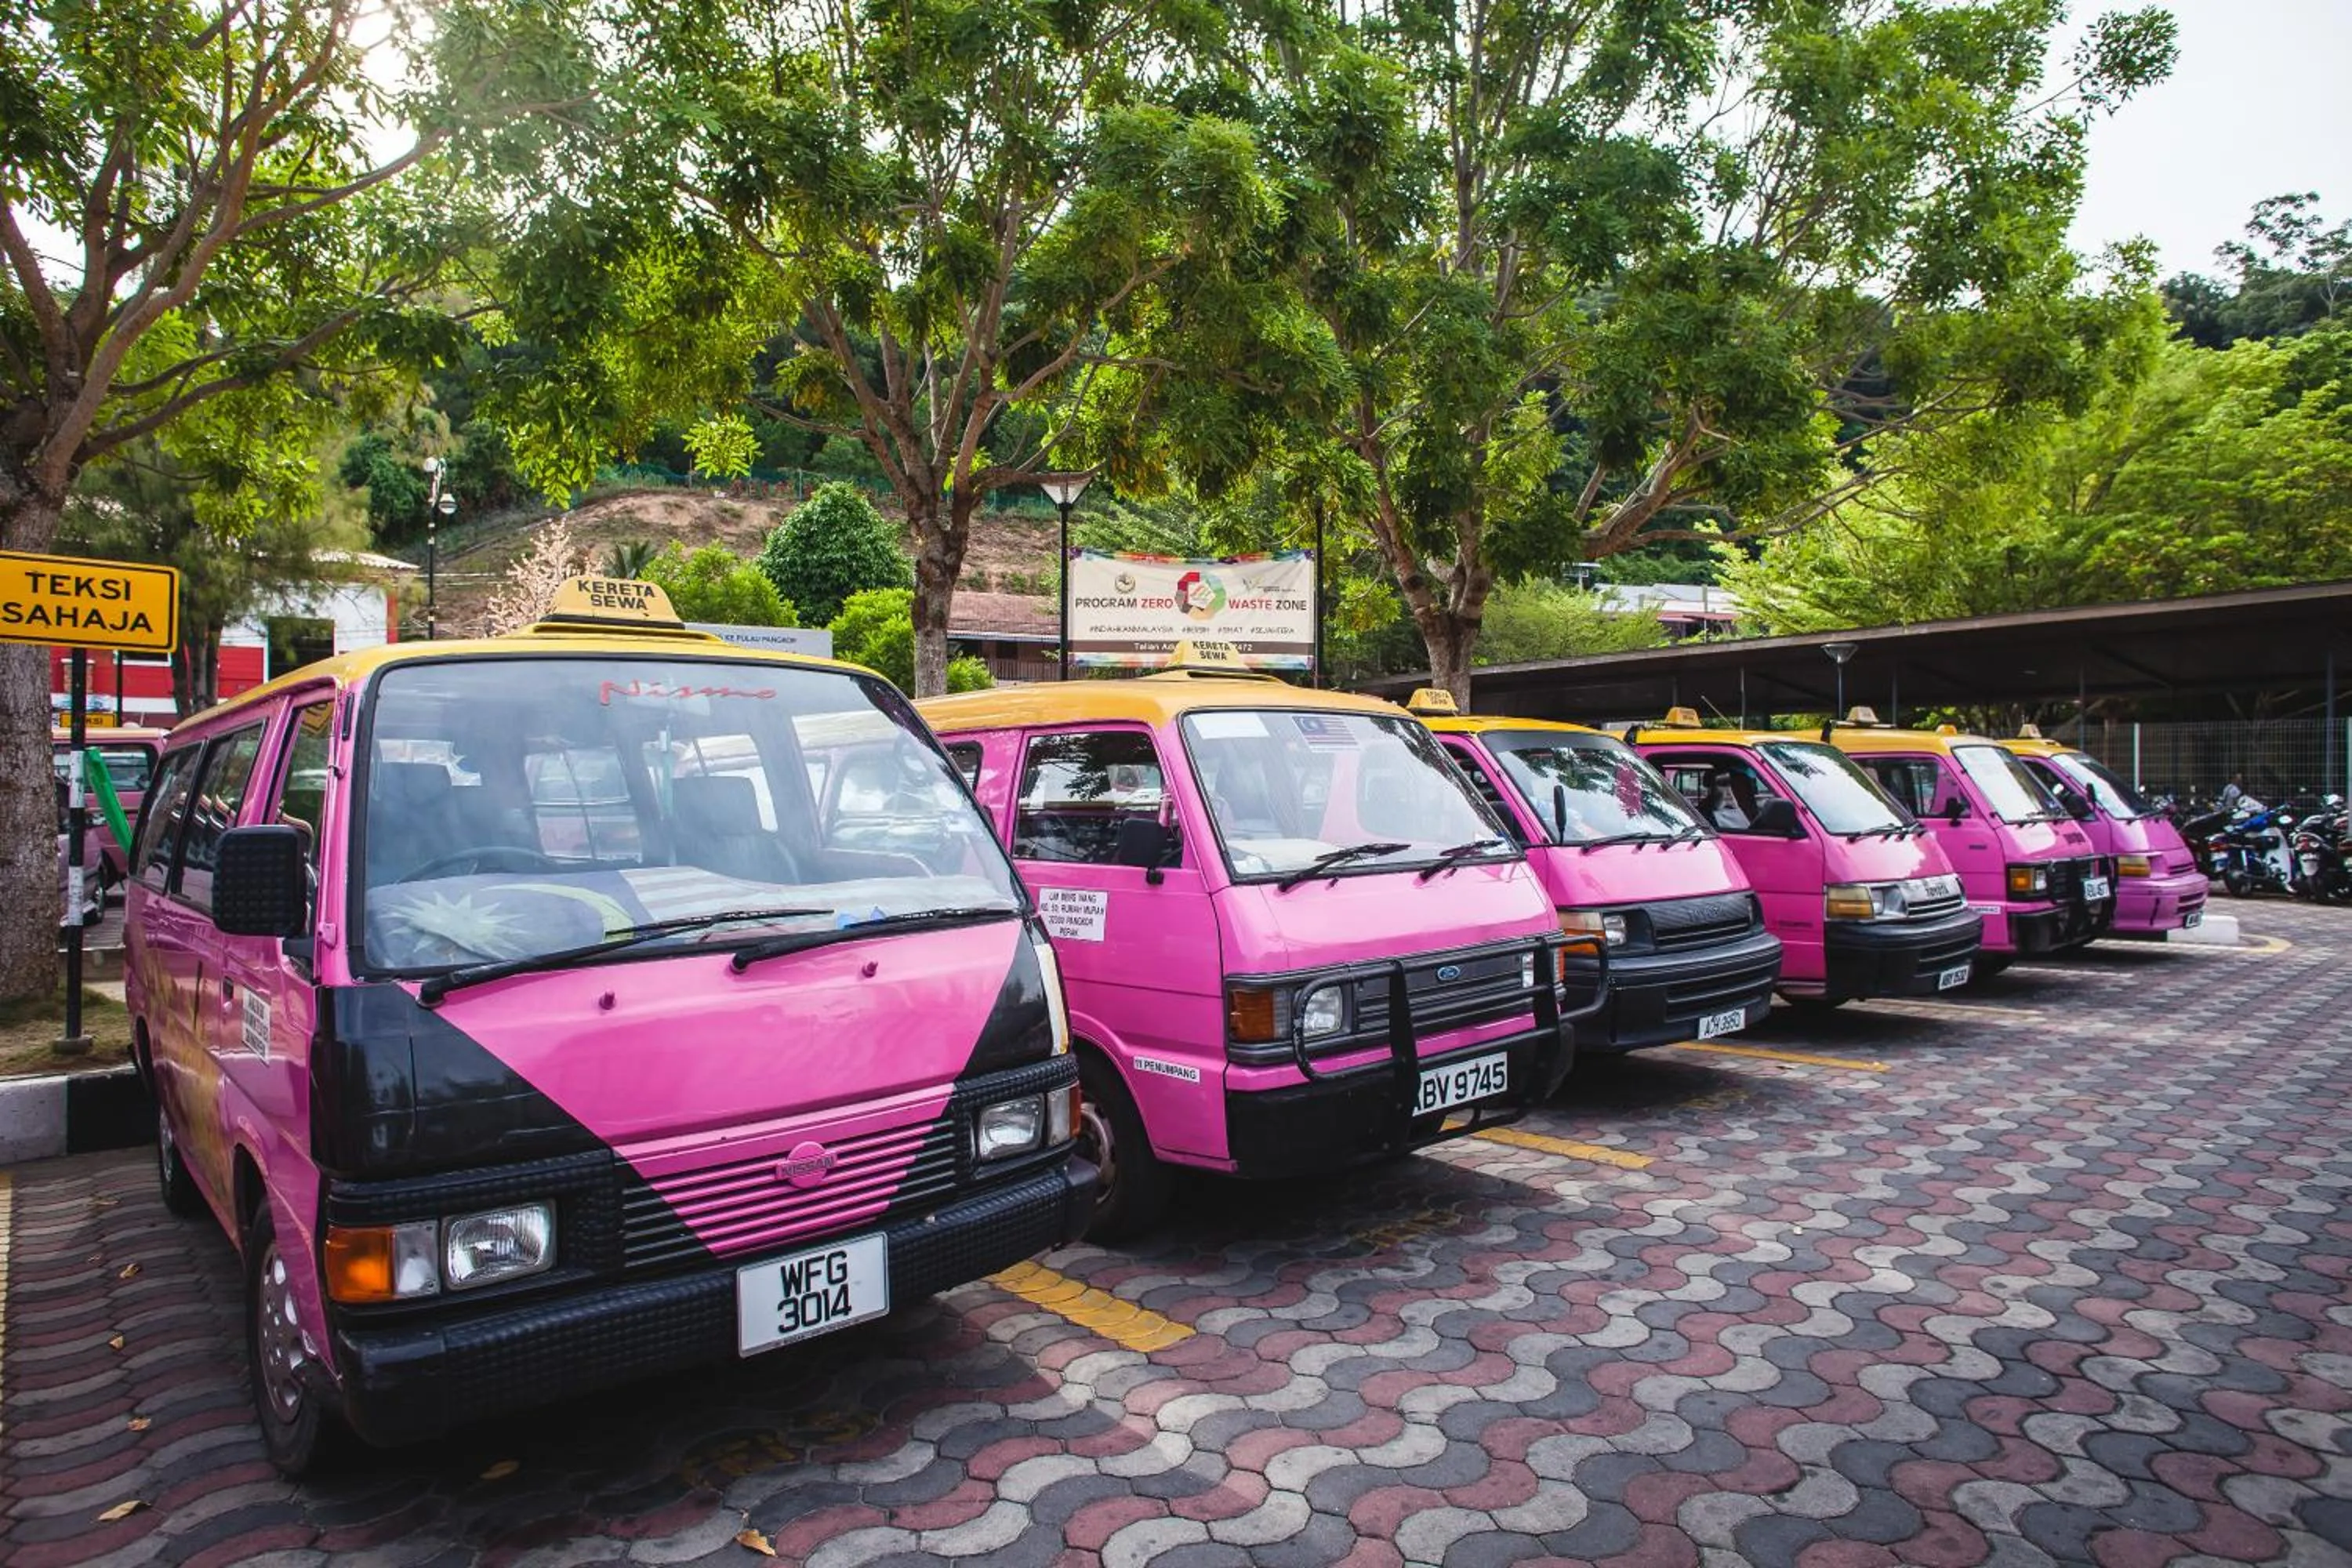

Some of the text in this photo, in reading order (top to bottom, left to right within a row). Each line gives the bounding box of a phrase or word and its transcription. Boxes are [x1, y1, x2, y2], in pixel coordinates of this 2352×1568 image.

[24, 571, 131, 601] TEKSI
[577, 579, 655, 597] KERETA
[590, 594, 648, 610] SEWA
[1075, 597, 1307, 611] PROGRAM ZERO WASTE ZONE
[2, 601, 154, 633] SAHAJA
[1192, 641, 1231, 651] KERETA
[1200, 652, 1227, 660] SEWA
[1145, 1060, 1197, 1079] PENUMPANG
[1455, 1061, 1505, 1099] 9745
[781, 1250, 847, 1297] WFG
[778, 1283, 851, 1333] 3014
